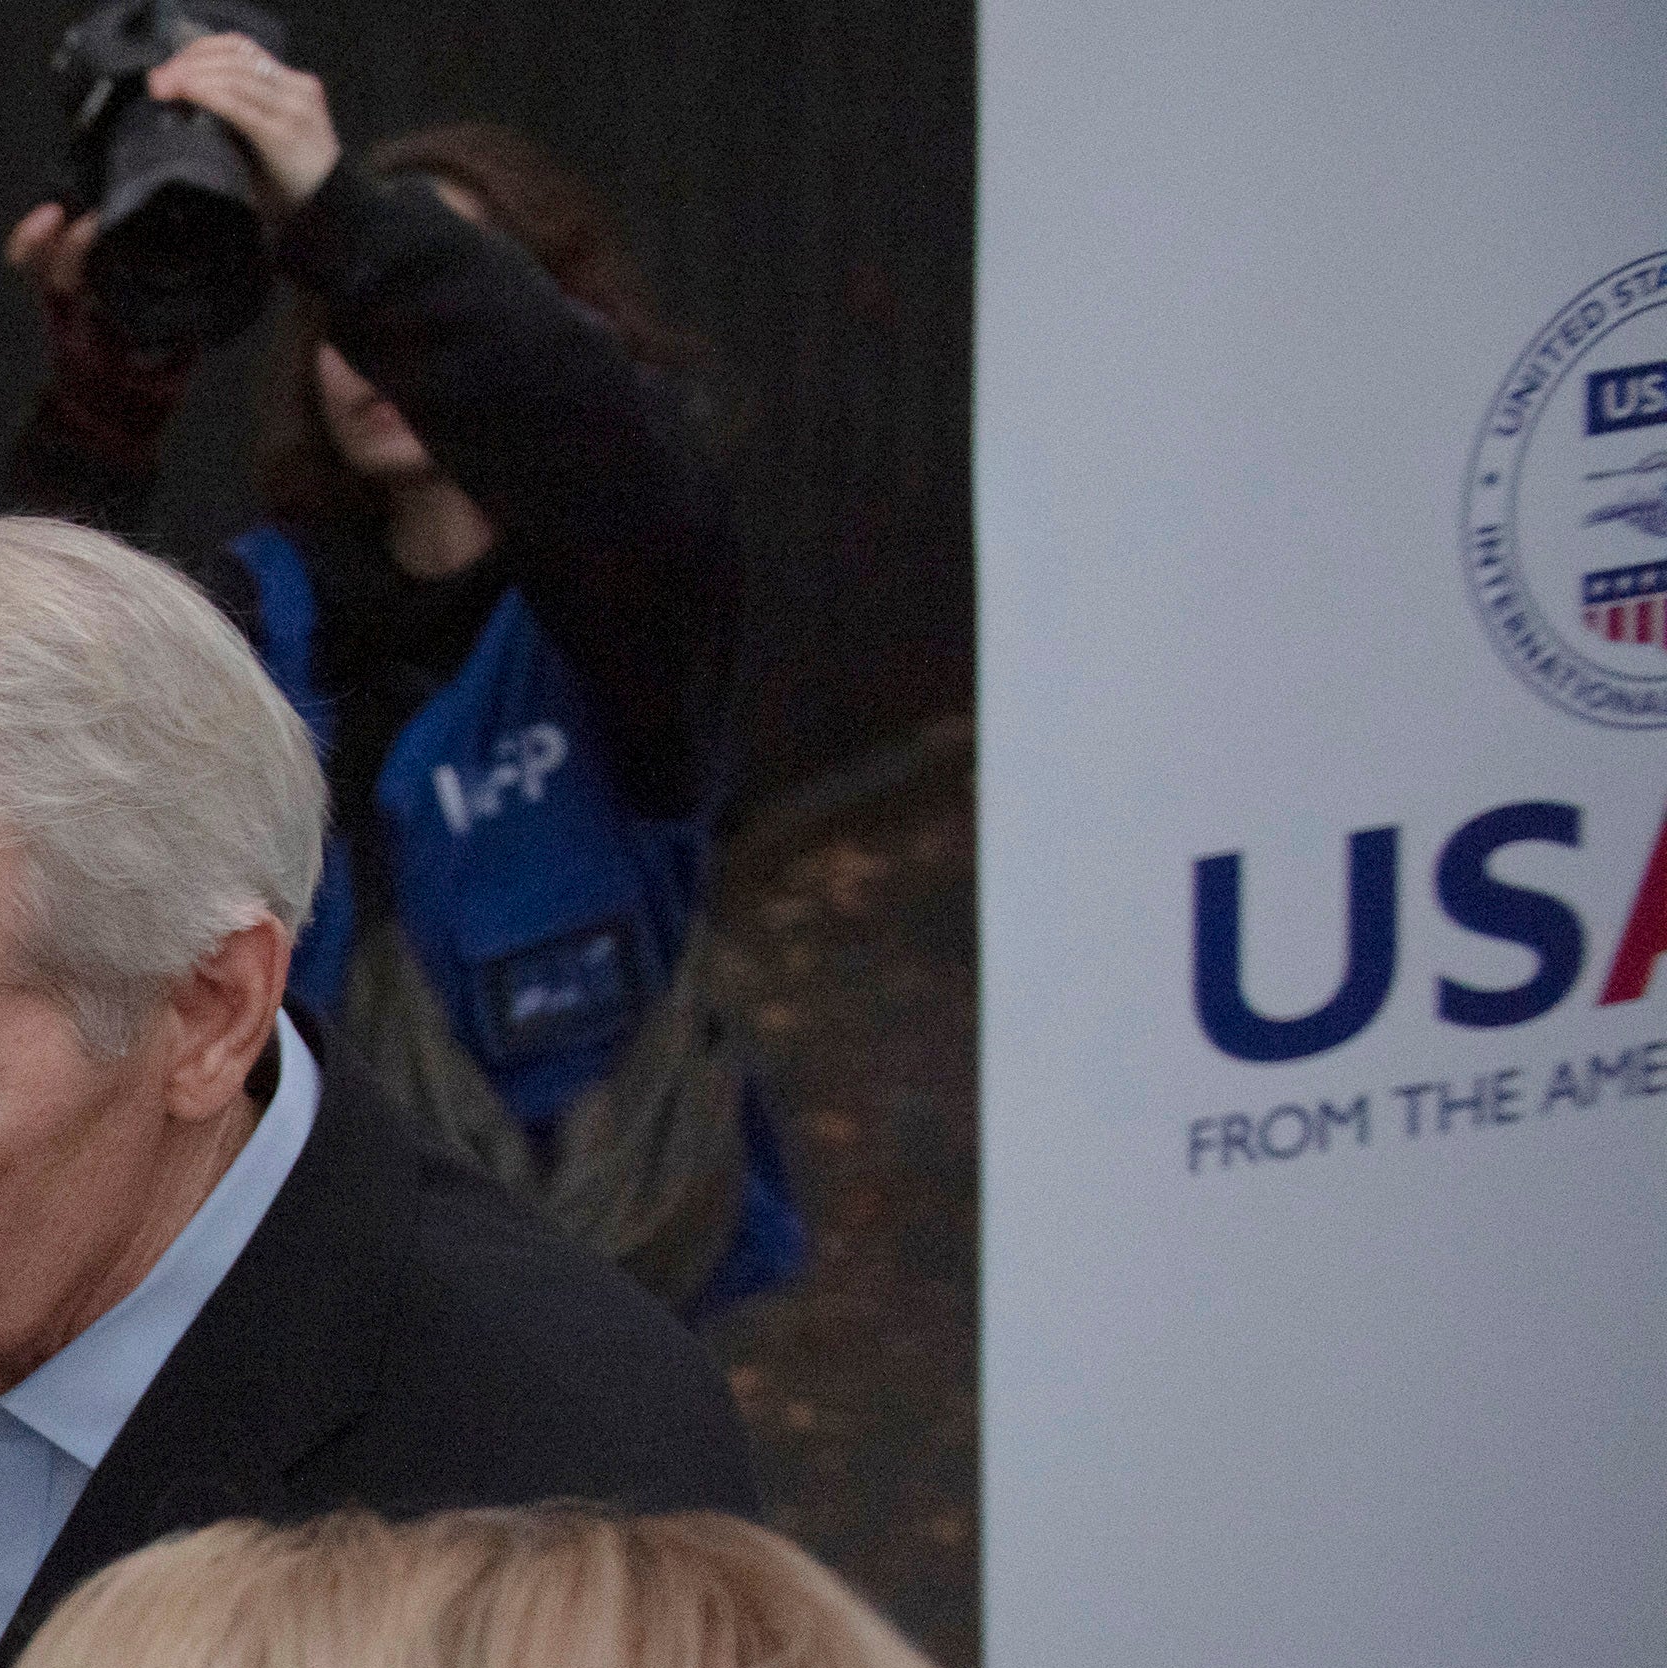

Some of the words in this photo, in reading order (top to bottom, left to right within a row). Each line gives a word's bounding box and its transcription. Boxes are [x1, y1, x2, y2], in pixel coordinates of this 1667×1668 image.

[1493, 299, 1607, 438] UNITED
[1474, 522, 1667, 716] INTERNATIONA
[1186, 1093, 1371, 1176] FROM
[1392, 1067, 1524, 1139] THE
